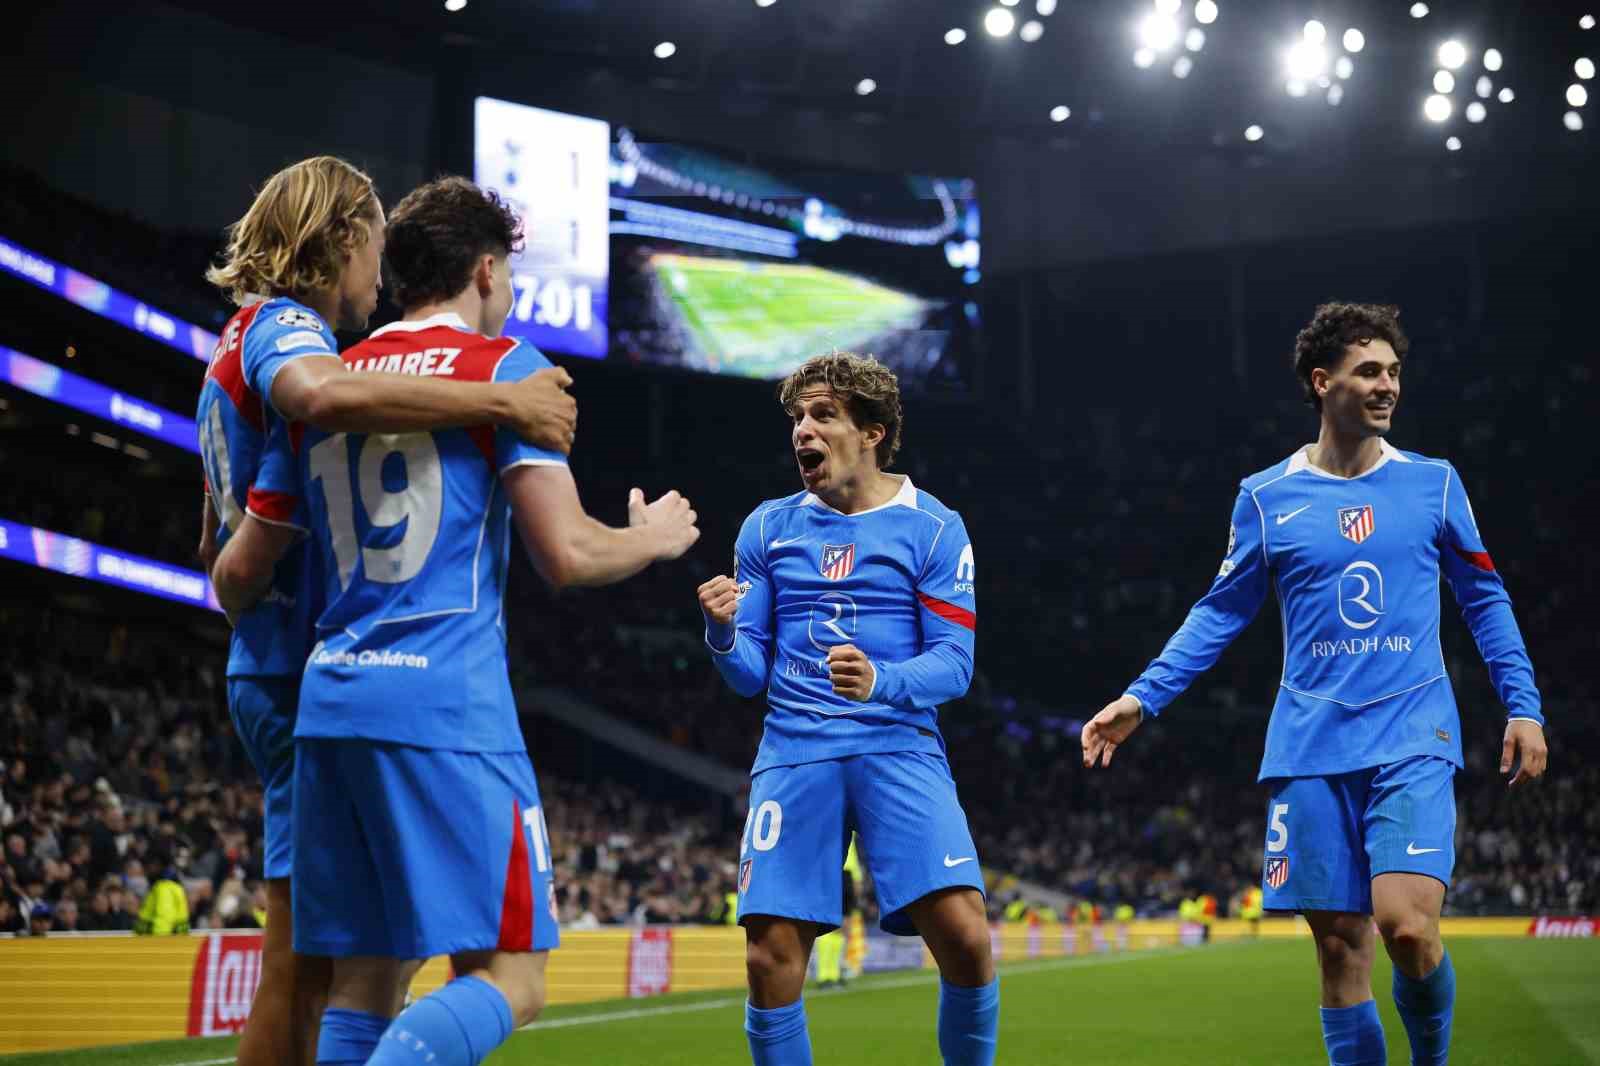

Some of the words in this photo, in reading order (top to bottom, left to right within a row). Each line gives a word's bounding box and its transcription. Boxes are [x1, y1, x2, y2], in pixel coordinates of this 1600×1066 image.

[309, 431, 442, 593] 19
[358, 648, 428, 669] Children
[1312, 636, 1379, 658] RIYADH
[1380, 635, 1412, 653] AIR
[785, 659, 831, 677] RIYA
[523, 805, 552, 873] 1
[1268, 803, 1289, 852] 5
